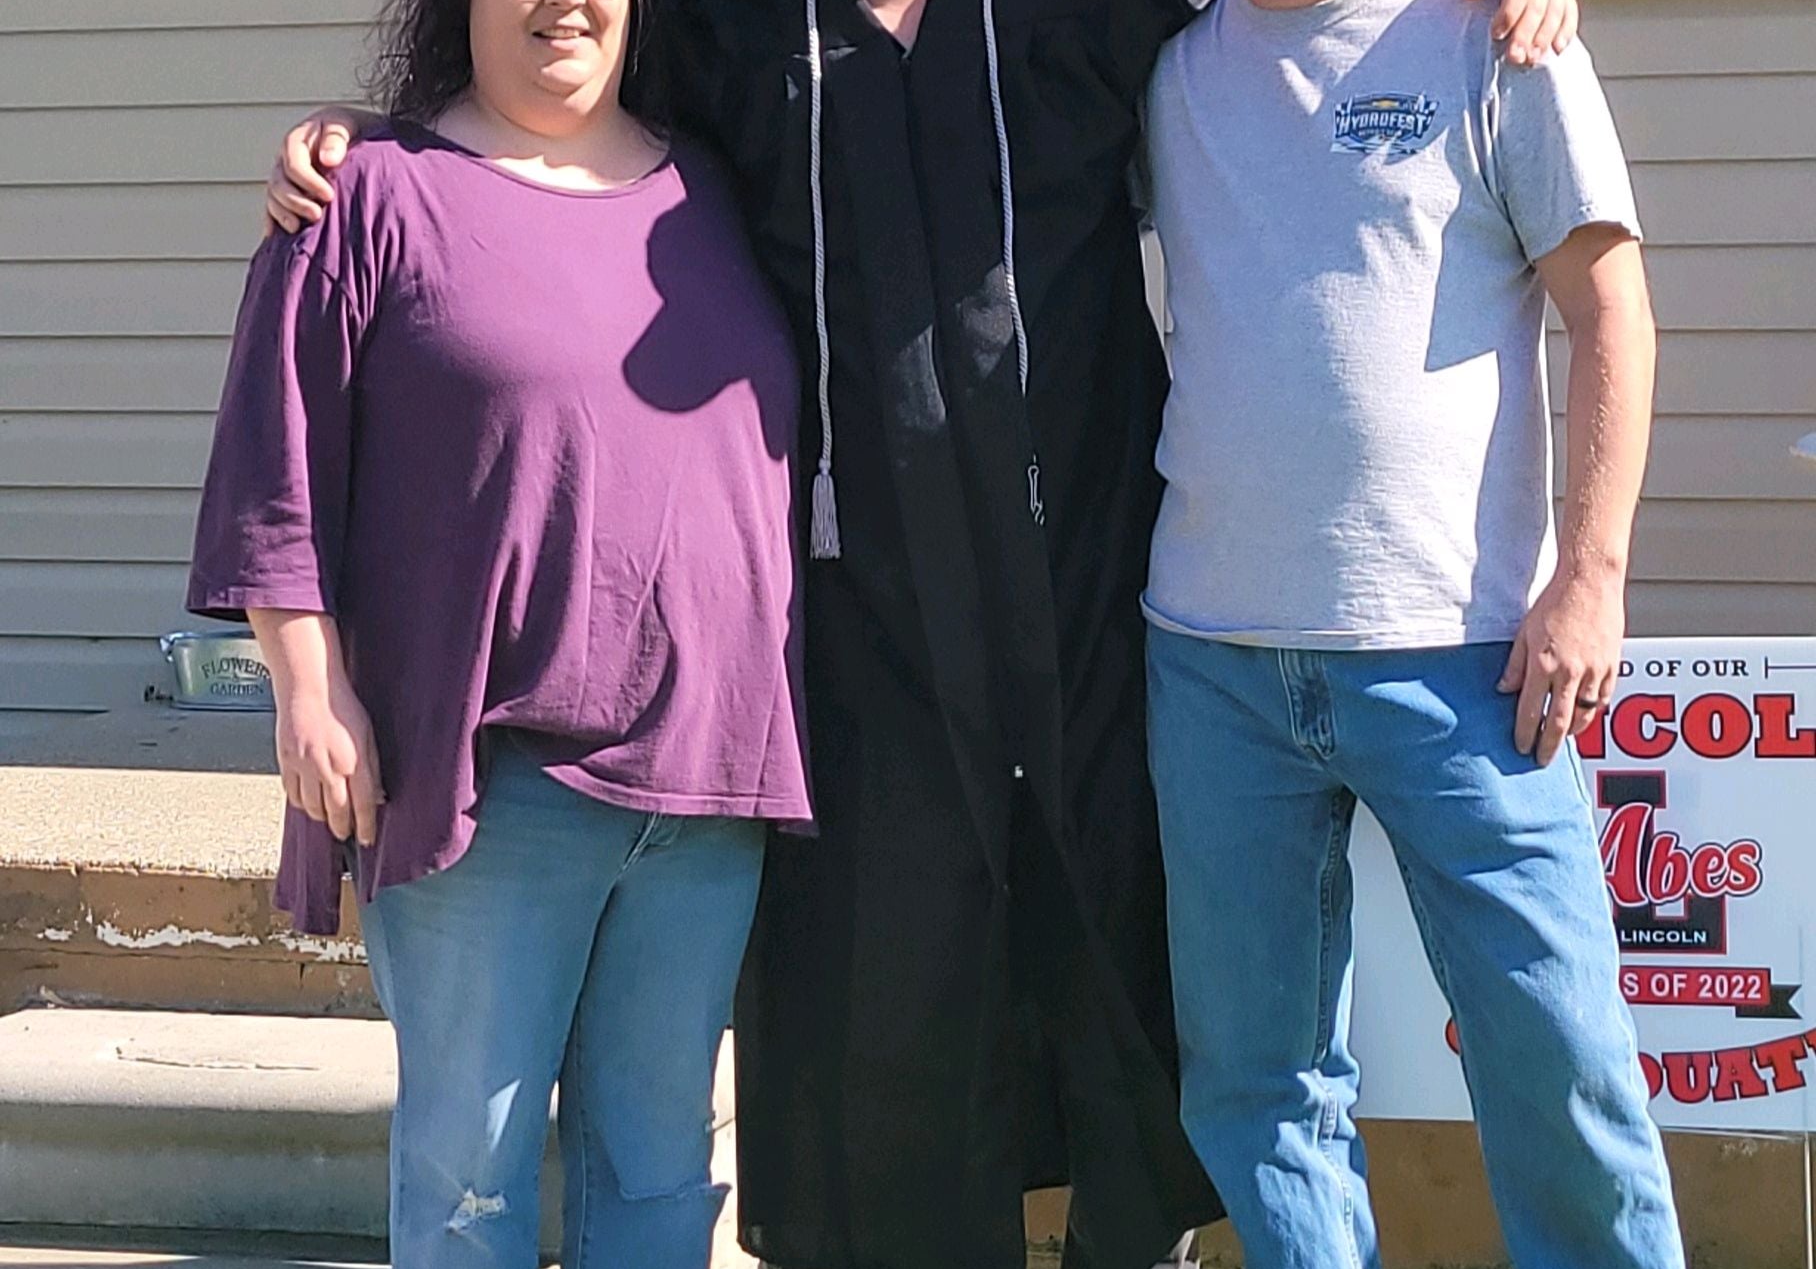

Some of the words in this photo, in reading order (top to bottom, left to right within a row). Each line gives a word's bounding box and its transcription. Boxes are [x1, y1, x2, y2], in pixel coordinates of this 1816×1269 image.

[1338, 111, 1428, 137] HYDROFEST
[1645, 659, 1682, 678] OF
[1692, 659, 1750, 677] OUR
[1599, 801, 1763, 908] Abes
[1620, 929, 1707, 944] LINCOLN
[1651, 973, 1688, 998] OF
[1698, 974, 1762, 1000] 2022
